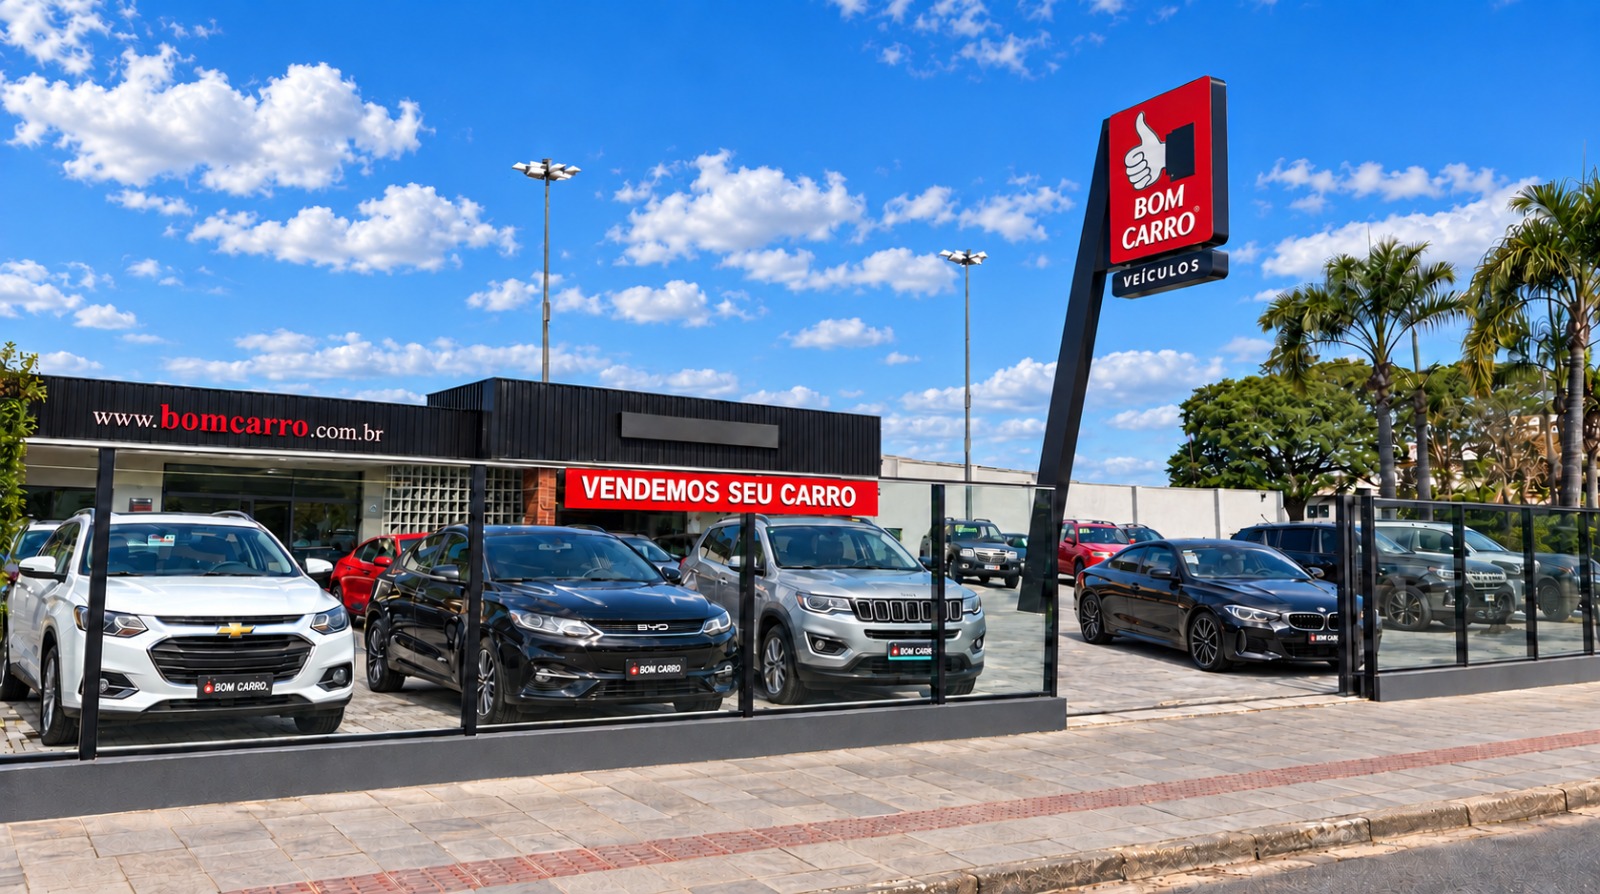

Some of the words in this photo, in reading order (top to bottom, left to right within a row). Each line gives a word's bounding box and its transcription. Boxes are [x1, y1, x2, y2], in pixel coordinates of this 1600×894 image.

[1134, 184, 1185, 220] BOM
[1121, 211, 1196, 250] CARRO
[1123, 258, 1199, 288] VEÍCULOS
[92, 403, 384, 442] www.bomcarro.com.br
[581, 475, 720, 503] VENDEMOS
[727, 481, 773, 505] SEU
[780, 483, 857, 508] CARRO
[637, 623, 669, 631] BYD
[639, 665, 656, 674] BOM
[657, 664, 681, 673] CARRO
[214, 682, 235, 692] BOM
